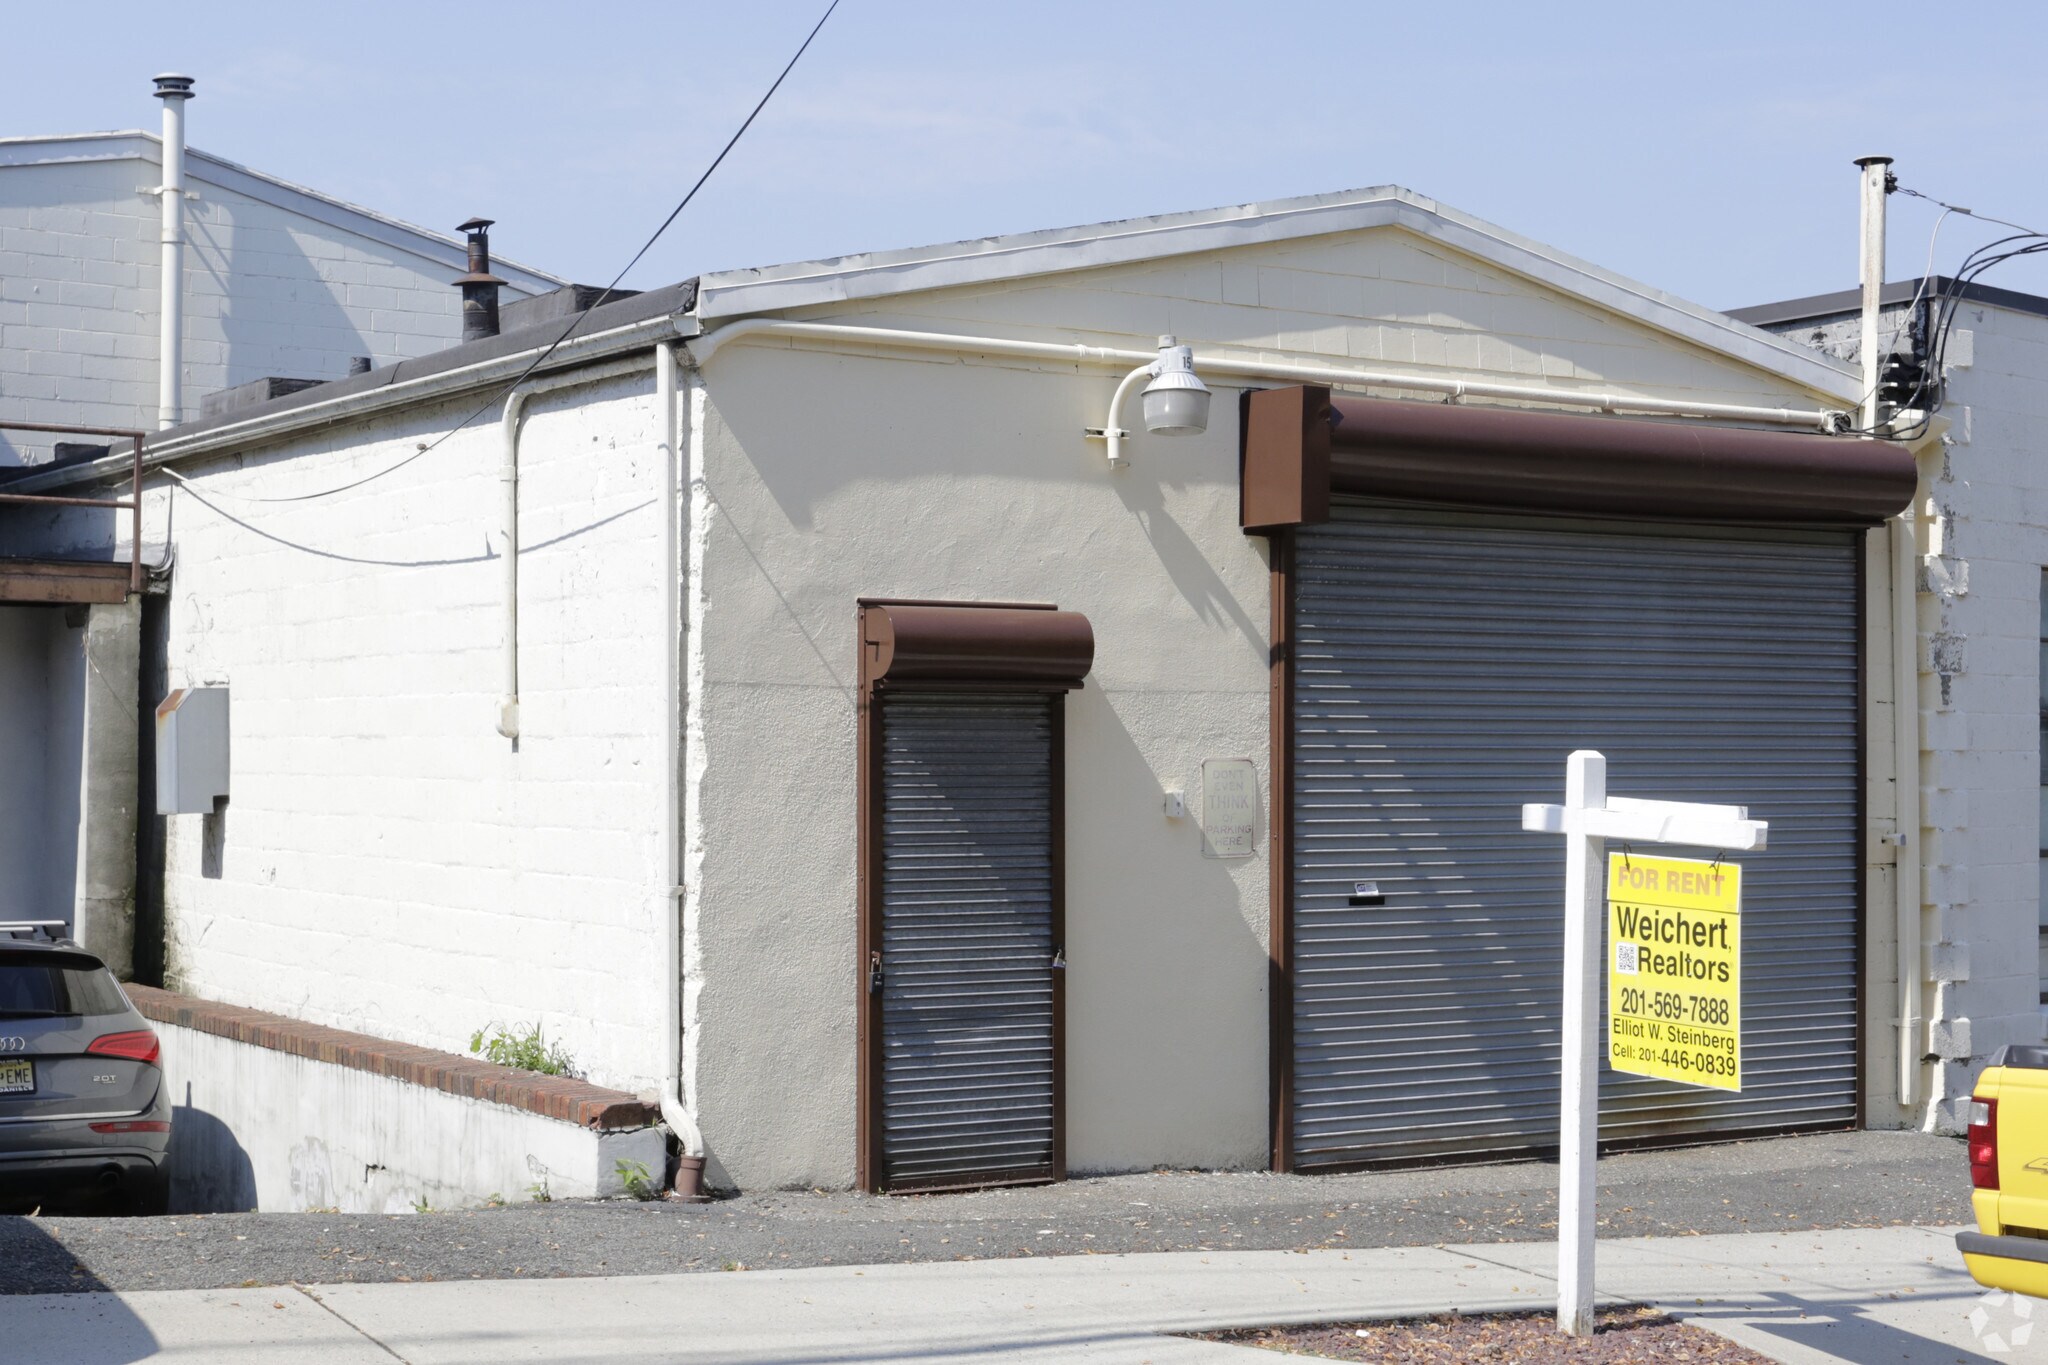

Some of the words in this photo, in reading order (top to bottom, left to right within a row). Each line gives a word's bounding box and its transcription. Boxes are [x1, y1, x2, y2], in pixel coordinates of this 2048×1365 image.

[1182, 356, 1192, 370] 15
[1214, 781, 1244, 792] EVEN
[1208, 794, 1249, 810] THINK
[1206, 824, 1252, 835] PARKING
[1222, 813, 1235, 823] OF
[1215, 836, 1243, 847] HERE
[1618, 865, 1659, 891] FOR
[1666, 870, 1725, 897] RENT
[1616, 905, 1732, 954] Weichert,
[1638, 945, 1730, 983] Realtors
[1621, 987, 1730, 1026] 201-569-7888
[1613, 1017, 1645, 1039] Elliot
[1648, 1022, 1664, 1041] W.
[1667, 1025, 1735, 1055] Steinberg
[1612, 1042, 1636, 1059] Cell:
[1638, 1047, 1736, 1077] 201-446-0839
